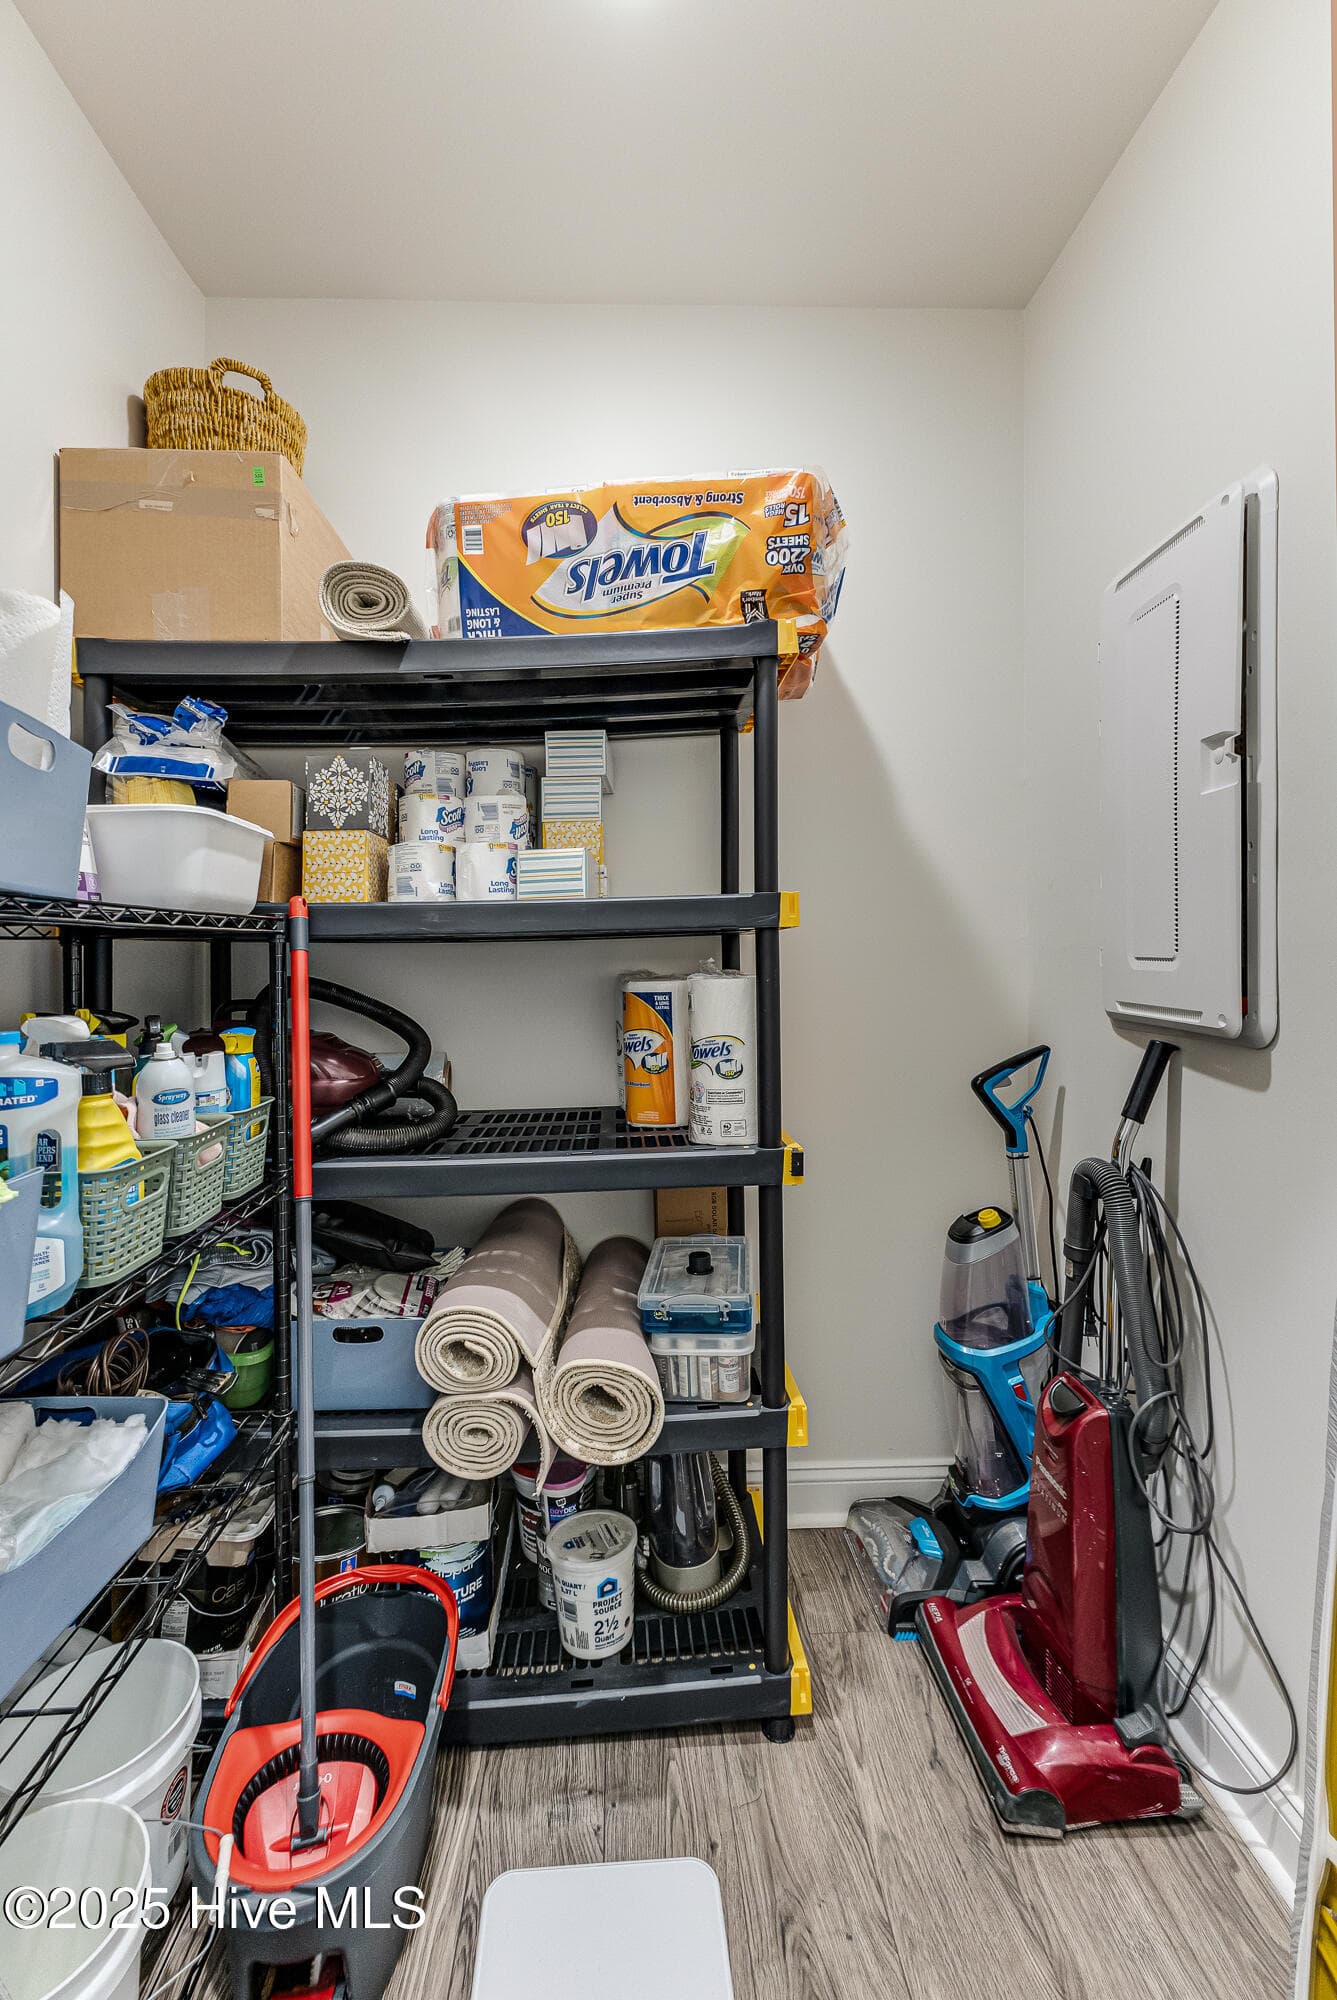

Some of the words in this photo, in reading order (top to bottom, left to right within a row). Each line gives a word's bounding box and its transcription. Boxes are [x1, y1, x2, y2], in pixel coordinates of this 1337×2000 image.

[633, 493, 691, 507] Absorbent
[694, 494, 704, 506] &
[705, 491, 744, 505] Strong
[545, 510, 571, 528] 150
[783, 502, 810, 528] 15
[766, 533, 810, 550] SHEETS
[765, 546, 811, 567] 2200
[565, 530, 717, 604] Towels
[602, 580, 652, 597] Premium
[610, 590, 643, 604] Super
[465, 606, 500, 617] LASTING
[466, 618, 492, 629] LONG
[492, 617, 501, 627] &
[440, 806, 463, 825] Scott
[418, 834, 445, 842] Lasting
[420, 829, 439, 837] Long
[488, 886, 515, 895] Lasting
[490, 880, 509, 889] Long
[624, 1036, 653, 1053] wels
[158, 1092, 187, 1102] Sprayway
[153, 1112, 170, 1127] glass
[170, 1109, 190, 1123] cleaner
[592, 1591, 624, 1609] PROJECT
[593, 1600, 622, 1616] SOURCE
[594, 1632, 615, 1644] Quart
